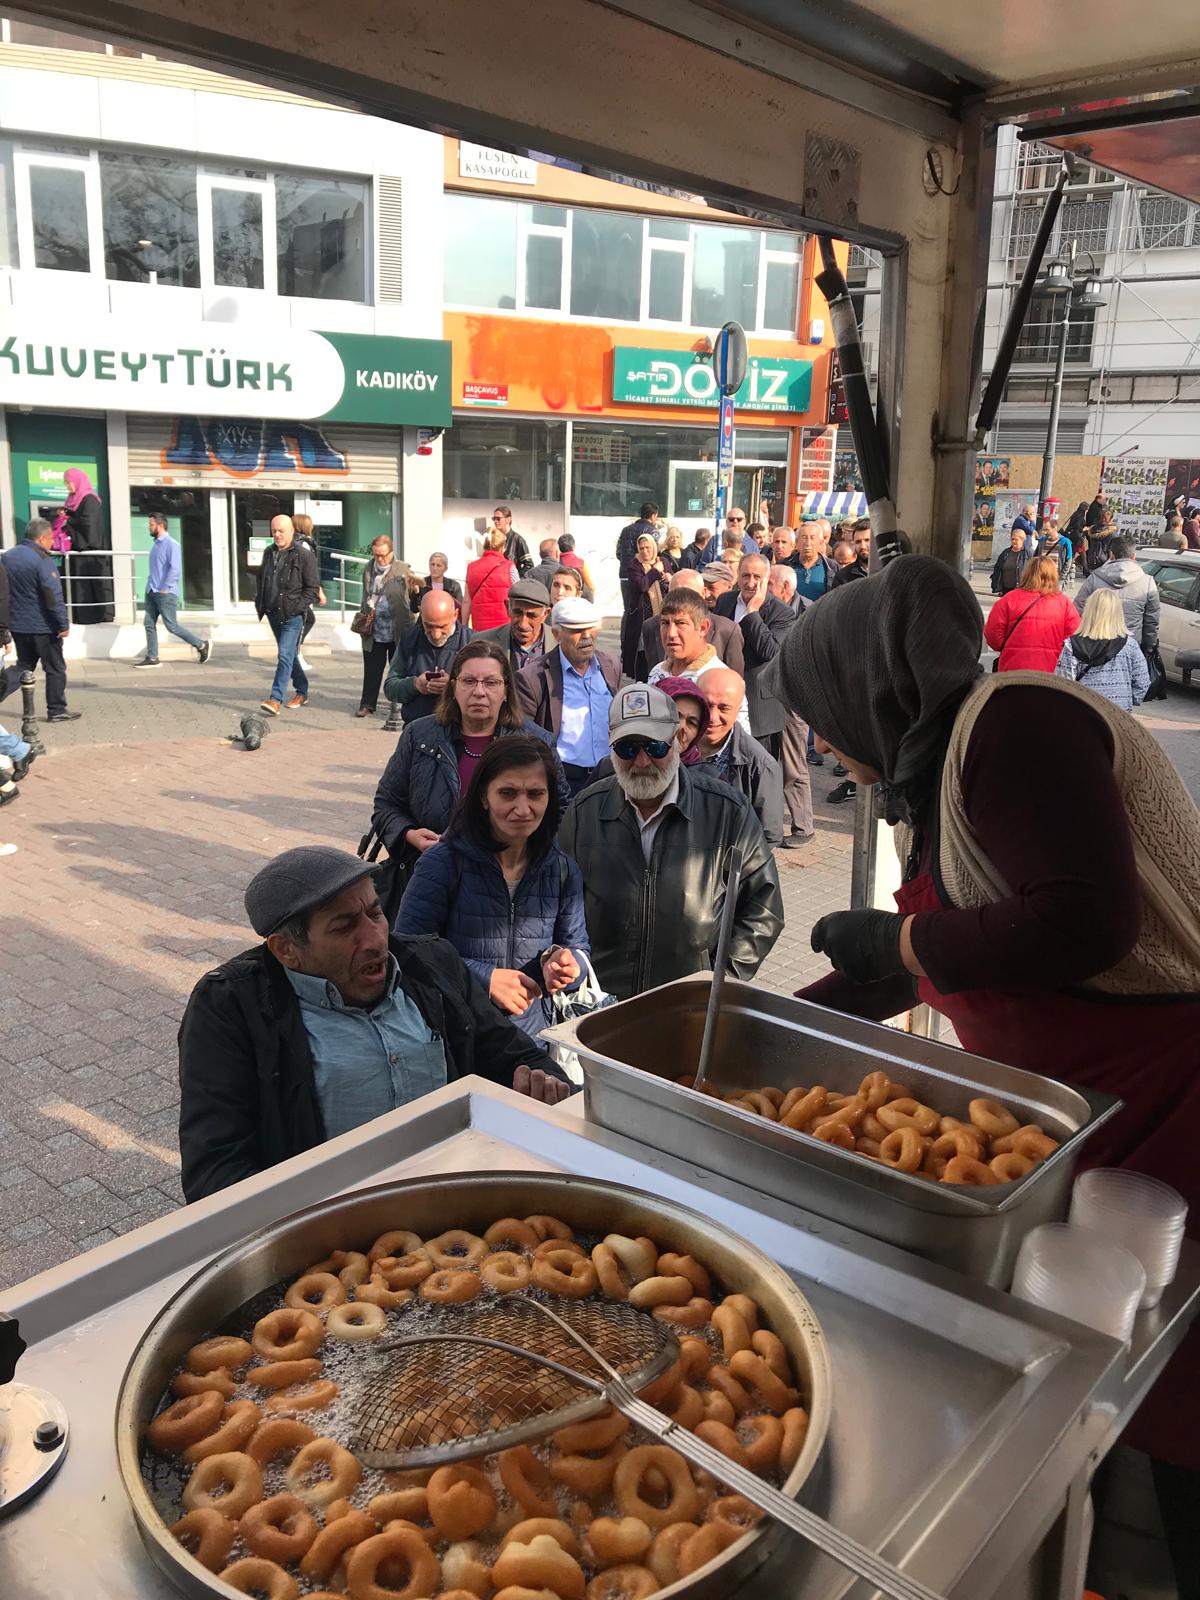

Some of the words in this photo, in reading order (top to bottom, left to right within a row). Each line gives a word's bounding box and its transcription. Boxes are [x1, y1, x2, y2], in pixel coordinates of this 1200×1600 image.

[356, 369, 439, 391] KADIKÖY
[649, 356, 789, 404] DÖİZ
[625, 394, 653, 402] TİCARET
